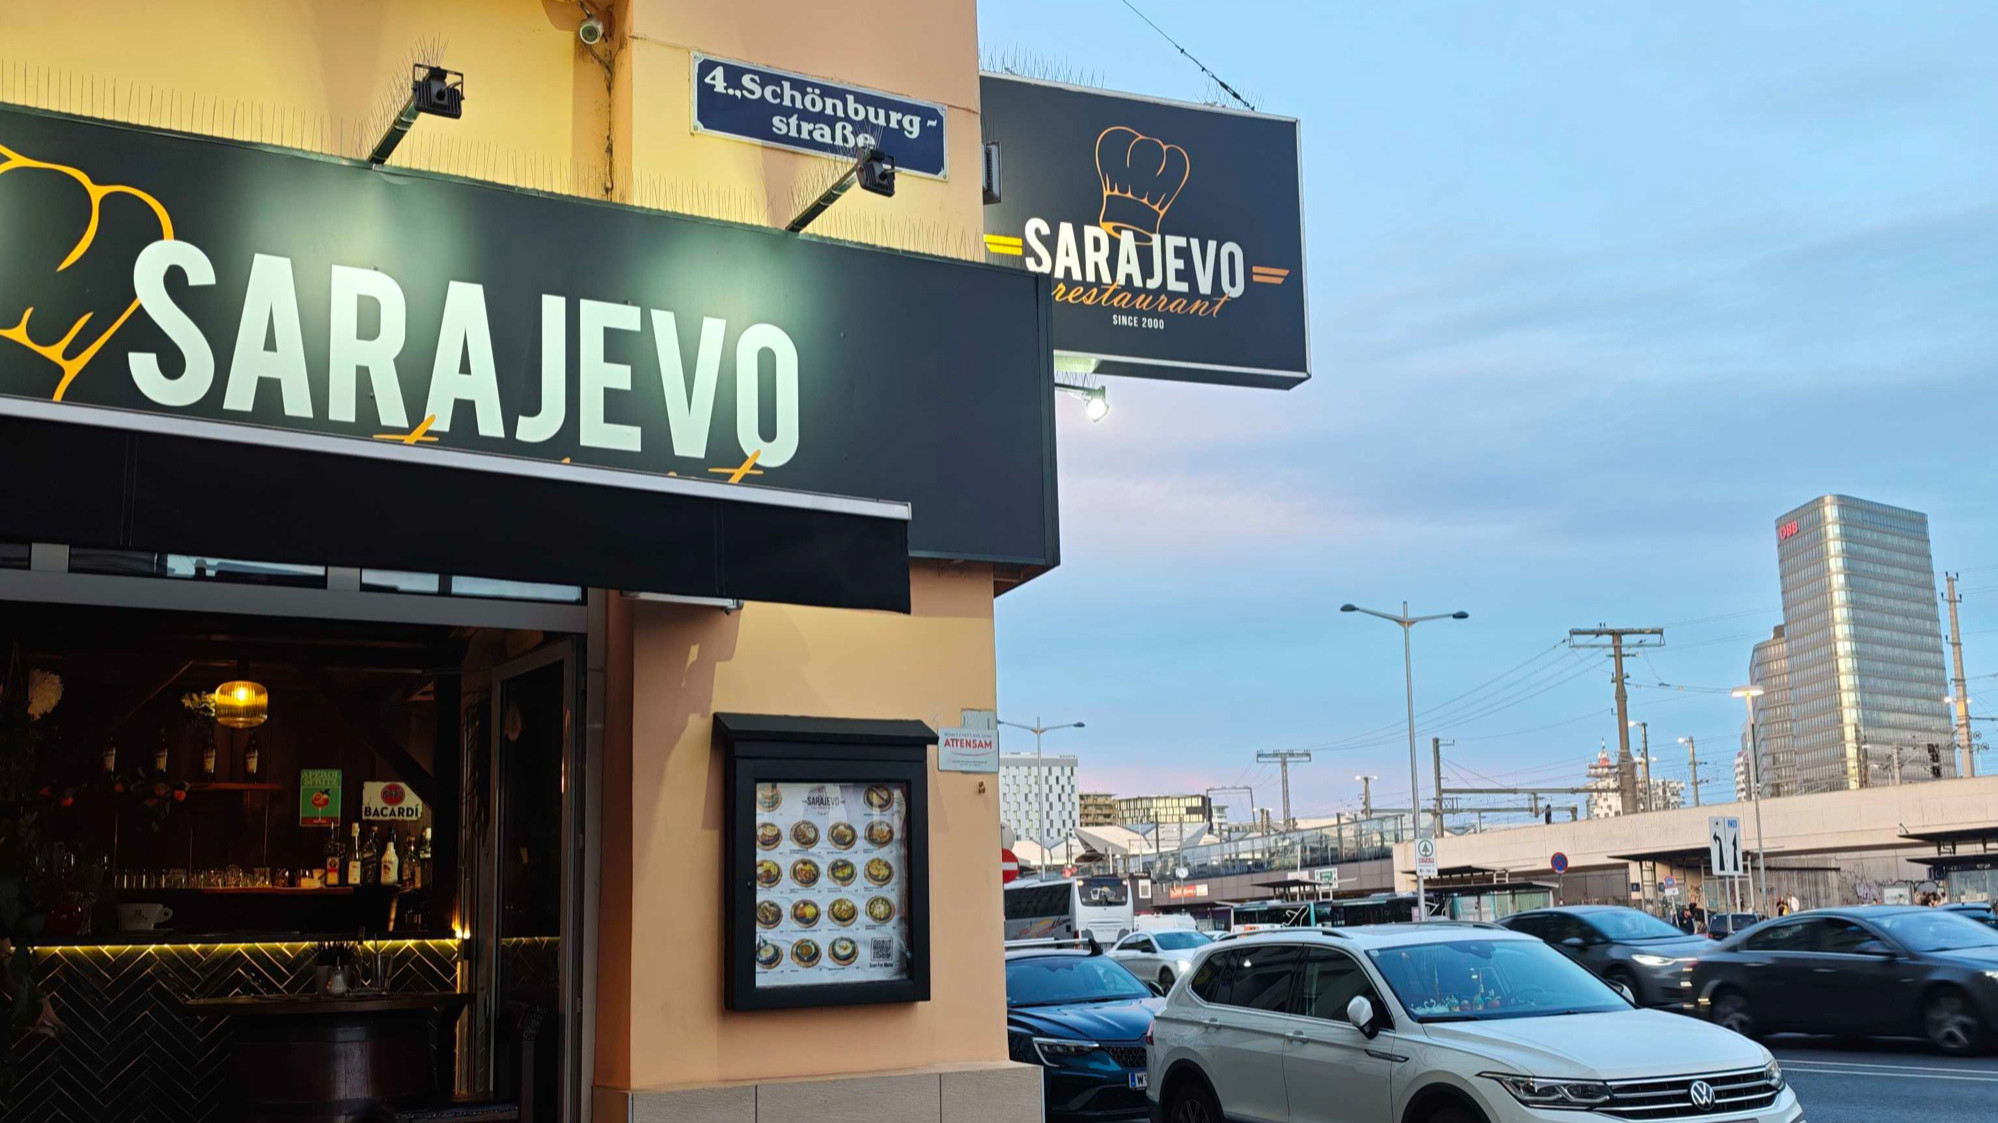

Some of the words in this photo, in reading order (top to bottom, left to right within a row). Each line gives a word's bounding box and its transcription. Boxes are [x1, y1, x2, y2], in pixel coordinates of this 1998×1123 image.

[772, 114, 876, 150] straße
[1024, 217, 1245, 299] SARAJEVO
[1052, 279, 1232, 318] restaurant
[1112, 314, 1139, 328] SINCE
[1142, 318, 1165, 330] 2000
[128, 239, 799, 467] SARAJEVO
[944, 738, 993, 750] ATTENSAM
[364, 804, 420, 817] BACARDÍ
[807, 795, 840, 806] SARAJEVO
